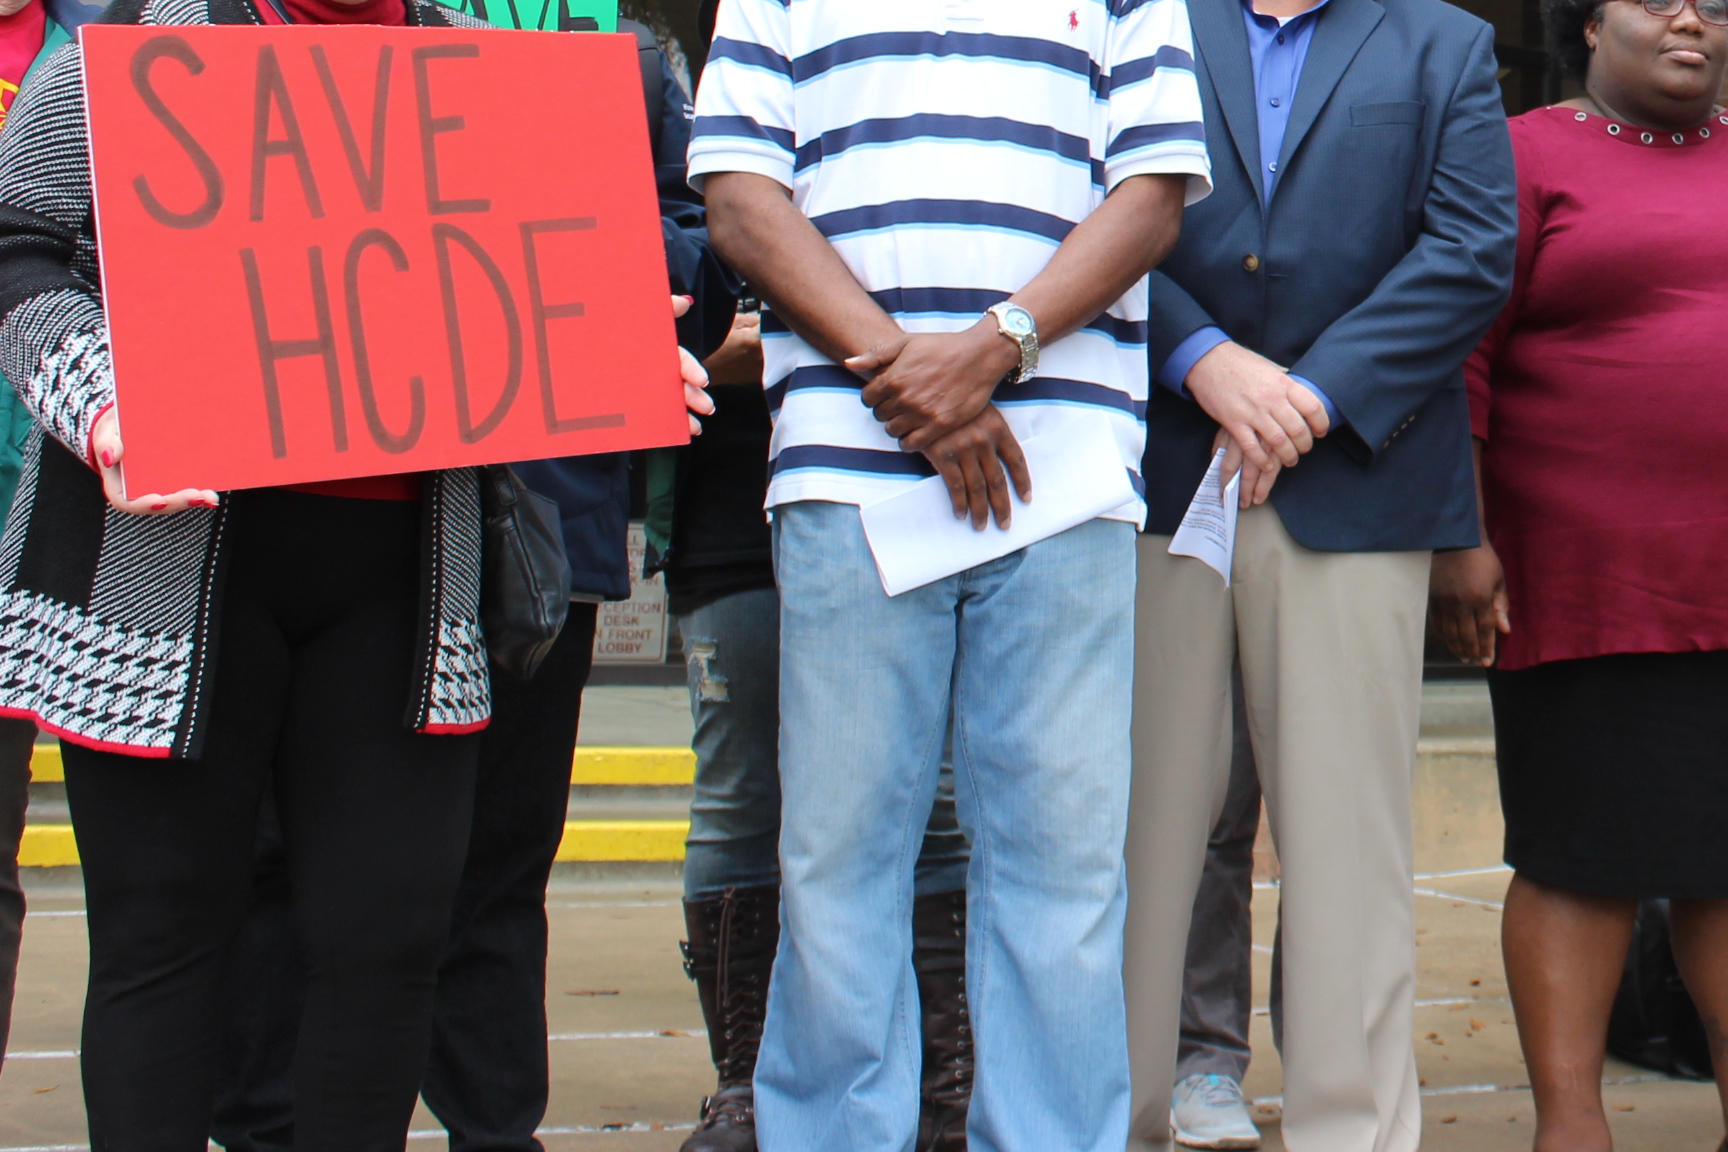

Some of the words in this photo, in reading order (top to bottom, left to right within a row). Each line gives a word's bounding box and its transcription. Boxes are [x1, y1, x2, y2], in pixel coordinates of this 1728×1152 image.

[130, 34, 491, 230] SAVE
[239, 215, 626, 459] HCDE
[603, 614, 638, 626] DESK
[607, 628, 652, 641] FRONT
[597, 641, 641, 654] LOBBY
